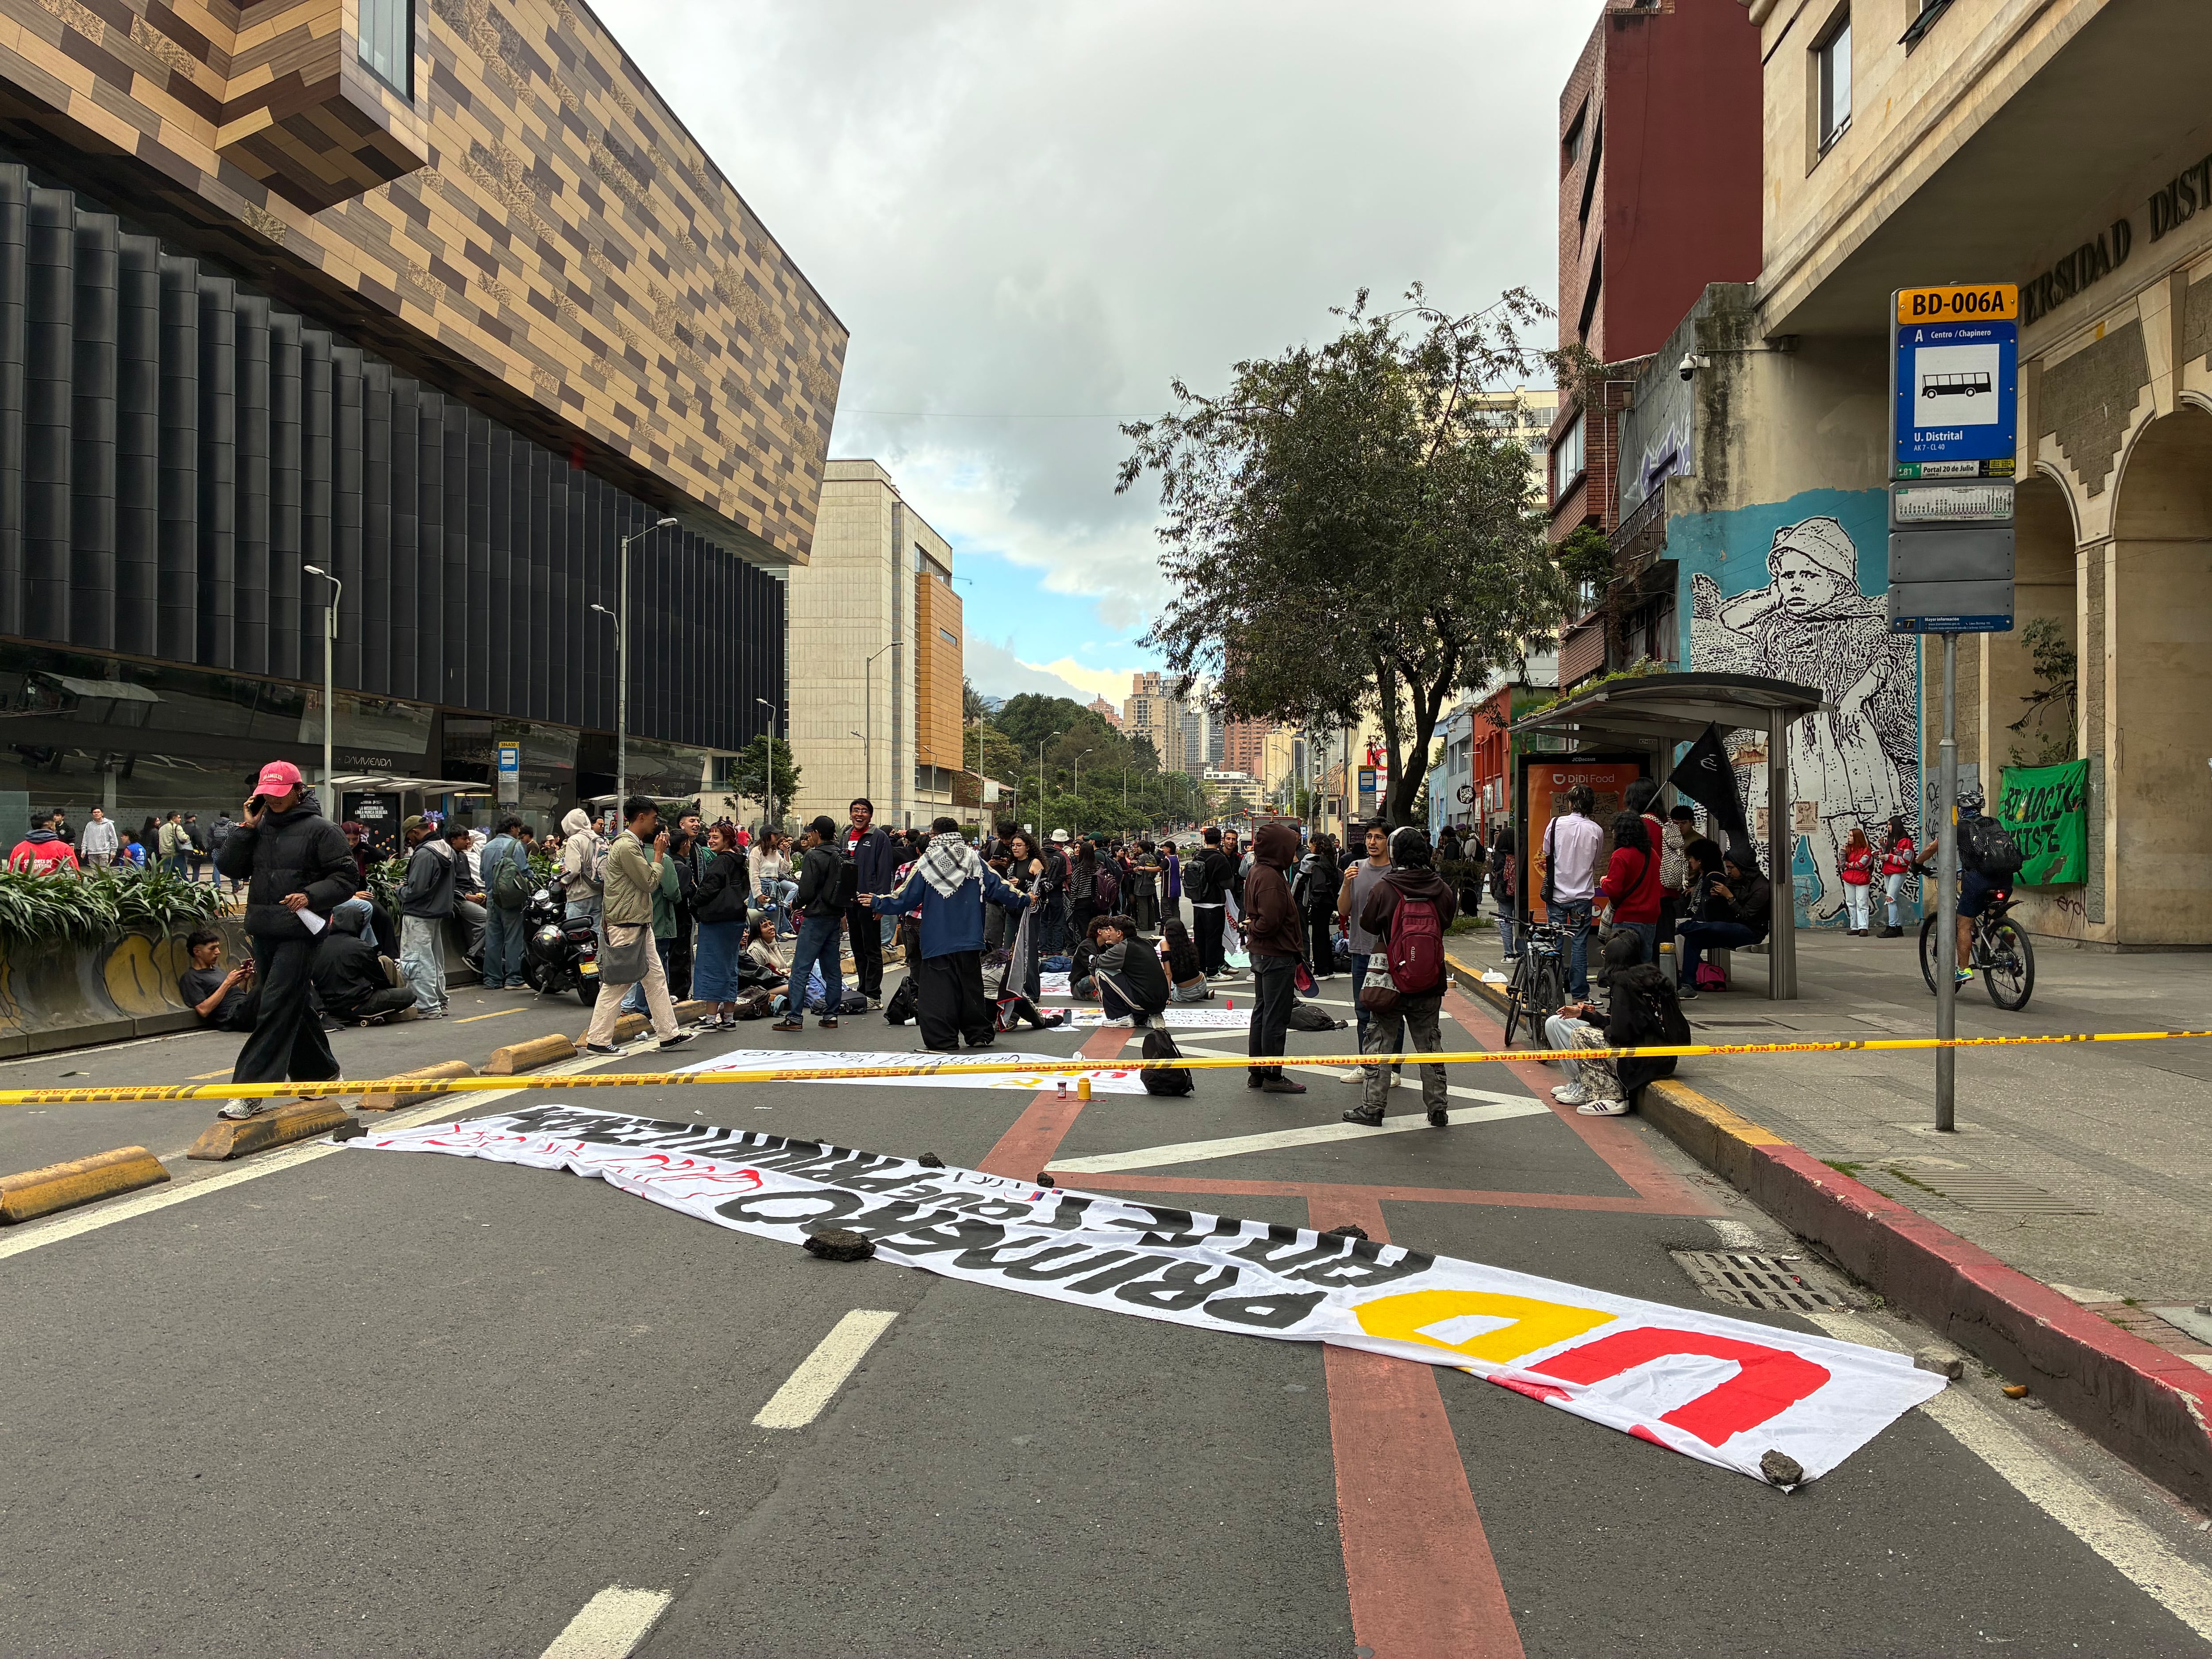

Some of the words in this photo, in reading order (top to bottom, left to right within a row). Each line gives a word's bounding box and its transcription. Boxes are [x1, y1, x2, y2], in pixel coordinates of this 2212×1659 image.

[2019, 219, 2131, 327] ERSIDAD
[1913, 291, 2004, 315] BD-006A
[1915, 330, 1923, 342] A
[1914, 433, 1924, 442] U.
[1926, 430, 1963, 442] Distrital
[344, 756, 392, 767] DAVIVIENDA
[1568, 774, 1588, 783] DiDi
[1590, 774, 1614, 783] Food
[1556, 805, 1567, 814] TE
[2006, 823, 2060, 861] SISTE
[886, 1183, 1034, 1220] QUE
[714, 1188, 1328, 1329] PRIMERO
